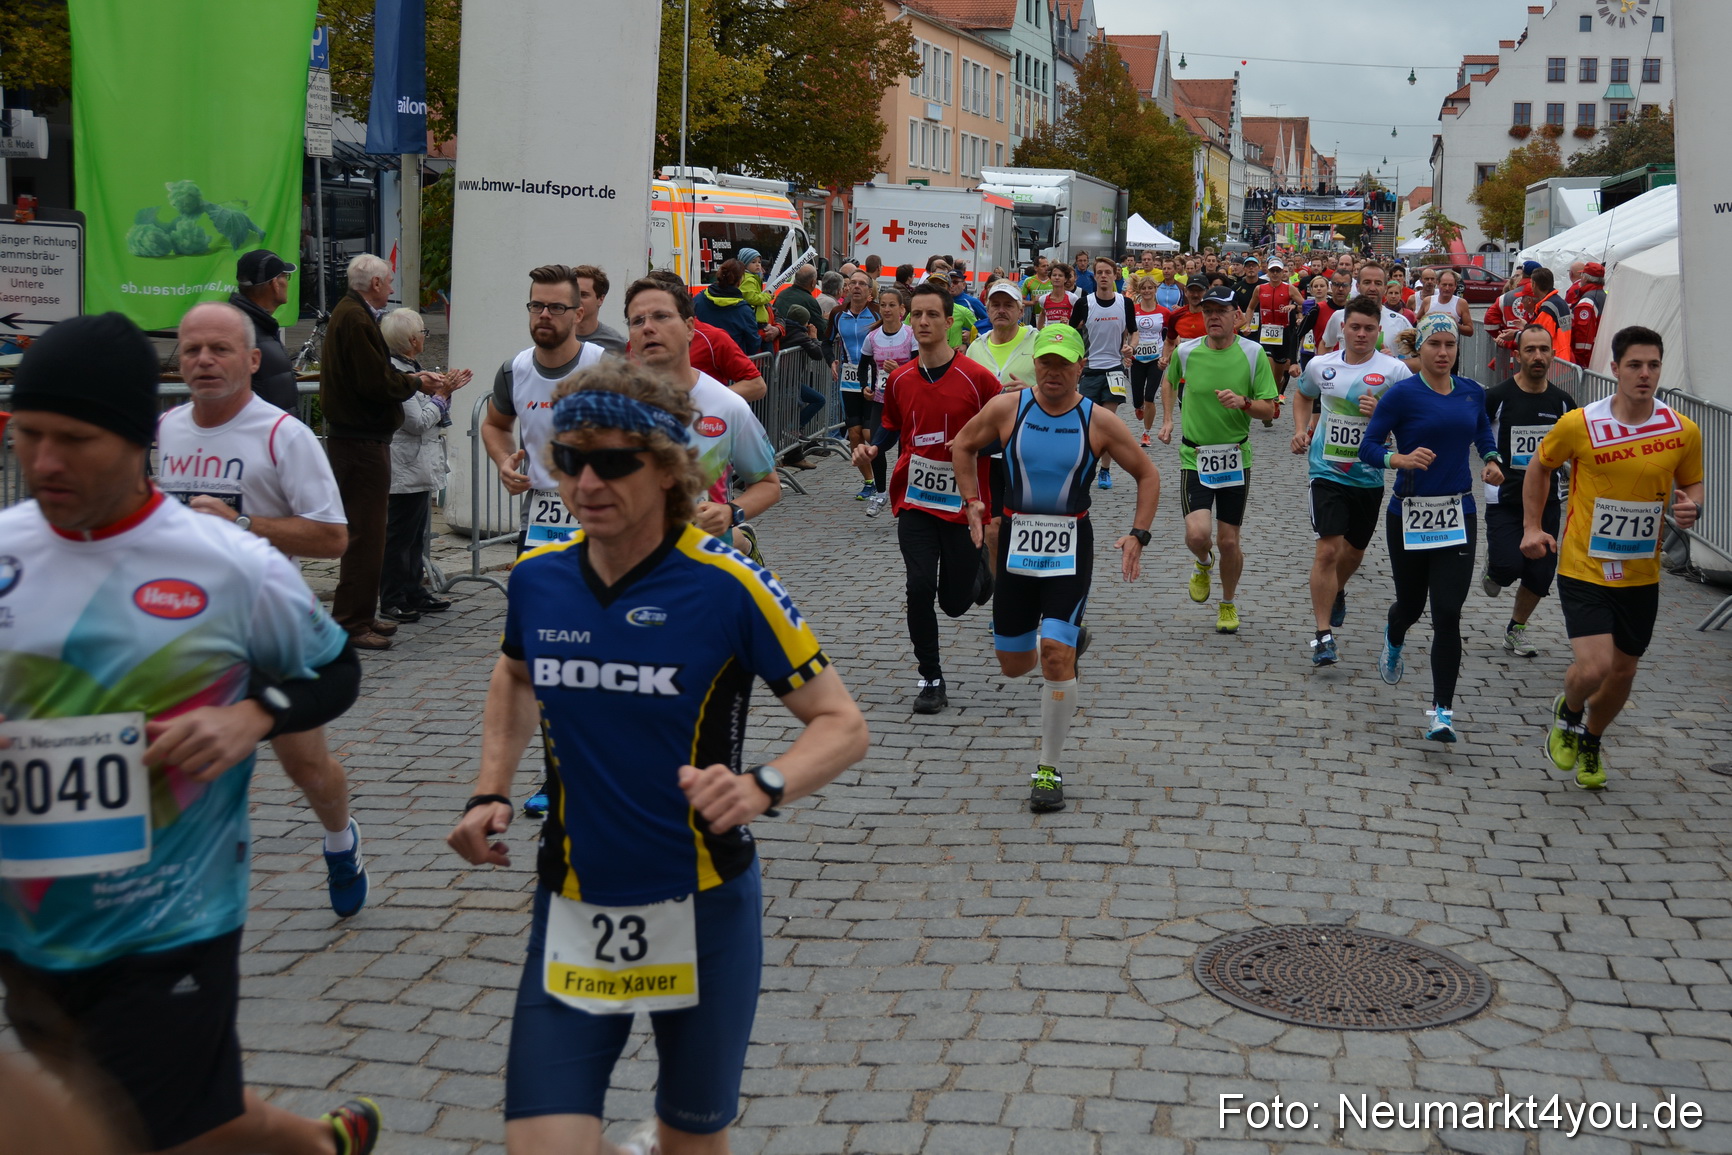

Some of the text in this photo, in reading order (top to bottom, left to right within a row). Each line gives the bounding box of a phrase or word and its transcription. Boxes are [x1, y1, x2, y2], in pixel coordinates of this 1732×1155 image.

[15, 139, 35, 149] Mode
[458, 177, 617, 200] www.bmw-laufsport.de
[1303, 213, 1334, 222] START
[908, 220, 950, 231] Bayerisches
[908, 229, 928, 237] Rotes
[33, 235, 77, 250] Richtung
[907, 237, 928, 245] Kreuz
[0, 250, 61, 262] ammsbräu-
[41, 265, 65, 276] über
[772, 250, 816, 291] bmw-laufsport.de
[11, 278, 45, 290] Untere
[1265, 329, 1279, 338] 503
[1137, 345, 1157, 356] 2003
[1328, 417, 1343, 426] PARTL
[1330, 425, 1366, 447] 503
[1594, 437, 1685, 466] MAX BÖGL
[161, 447, 244, 481] twinn
[911, 459, 928, 469] PARTL
[1201, 453, 1238, 473] 2613
[193, 480, 200, 489] &
[913, 468, 958, 493] 2651
[920, 492, 947, 503] Florian
[1595, 502, 1652, 516] PARTL Neumarkt
[1013, 520, 1066, 530] PARTL Neumarkt
[1409, 508, 1459, 530] 2242
[1598, 513, 1656, 540] 2713
[1016, 529, 1071, 554] 2029
[1420, 533, 1449, 542] Verena
[1607, 541, 1641, 553] Manuel
[1022, 557, 1061, 568] Christian
[537, 629, 591, 644] TEAM
[533, 656, 681, 697] BOCK
[29, 732, 112, 751] Neumarkt
[0, 753, 130, 817] 3040
[592, 913, 648, 963] 23
[565, 970, 678, 996] Franz Xaver
